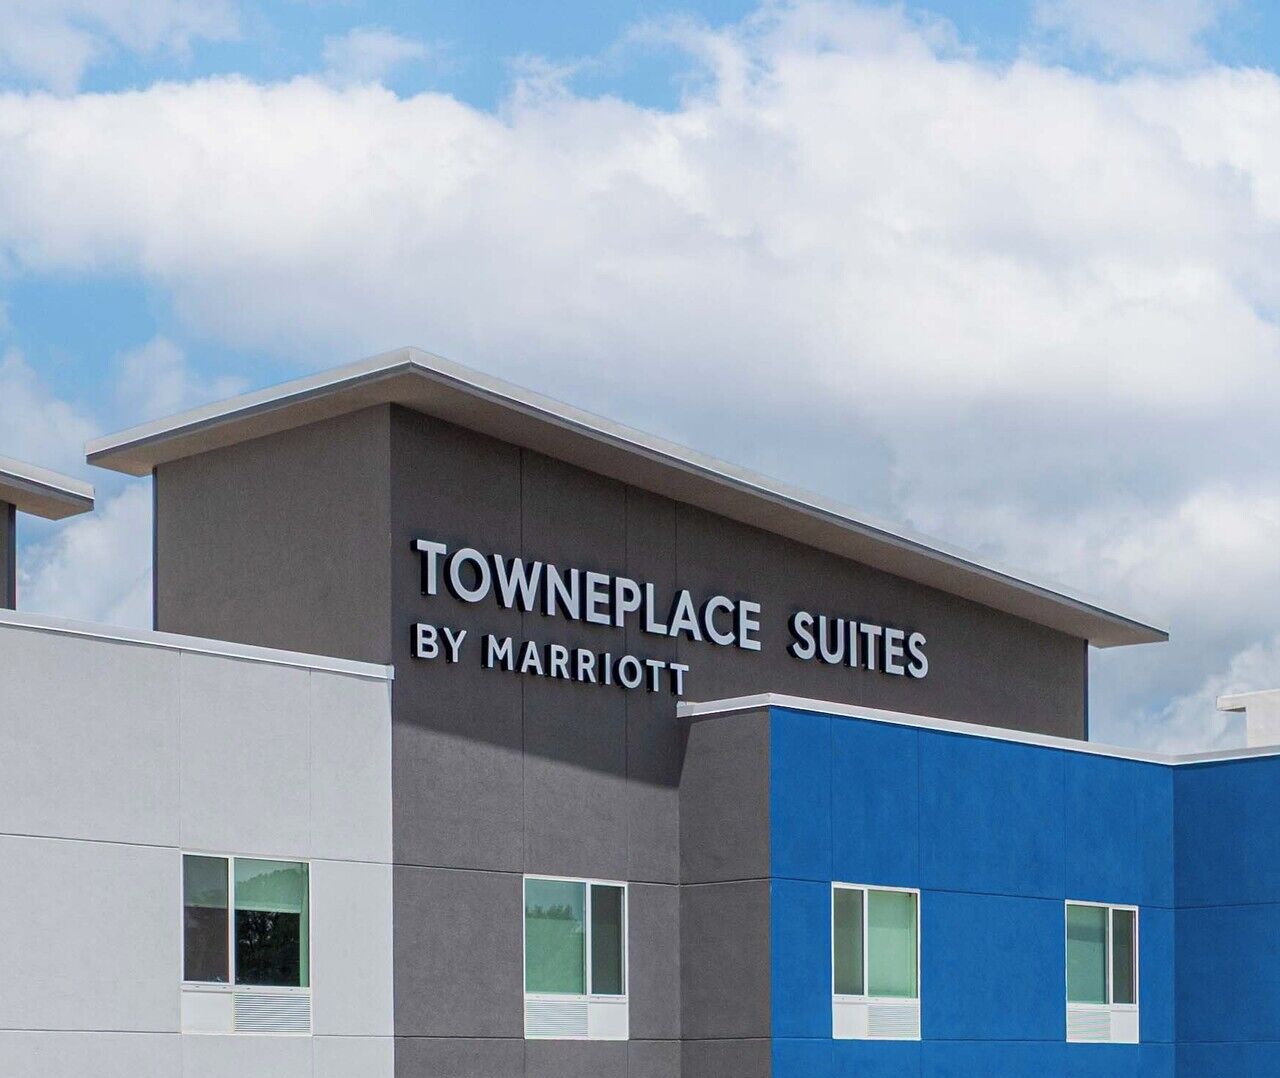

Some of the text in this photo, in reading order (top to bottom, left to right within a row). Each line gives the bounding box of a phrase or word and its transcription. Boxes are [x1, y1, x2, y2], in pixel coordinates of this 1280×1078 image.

[414, 538, 929, 679] TOWNEPLACE SUITES
[415, 622, 690, 696] BY MARRIOTT
